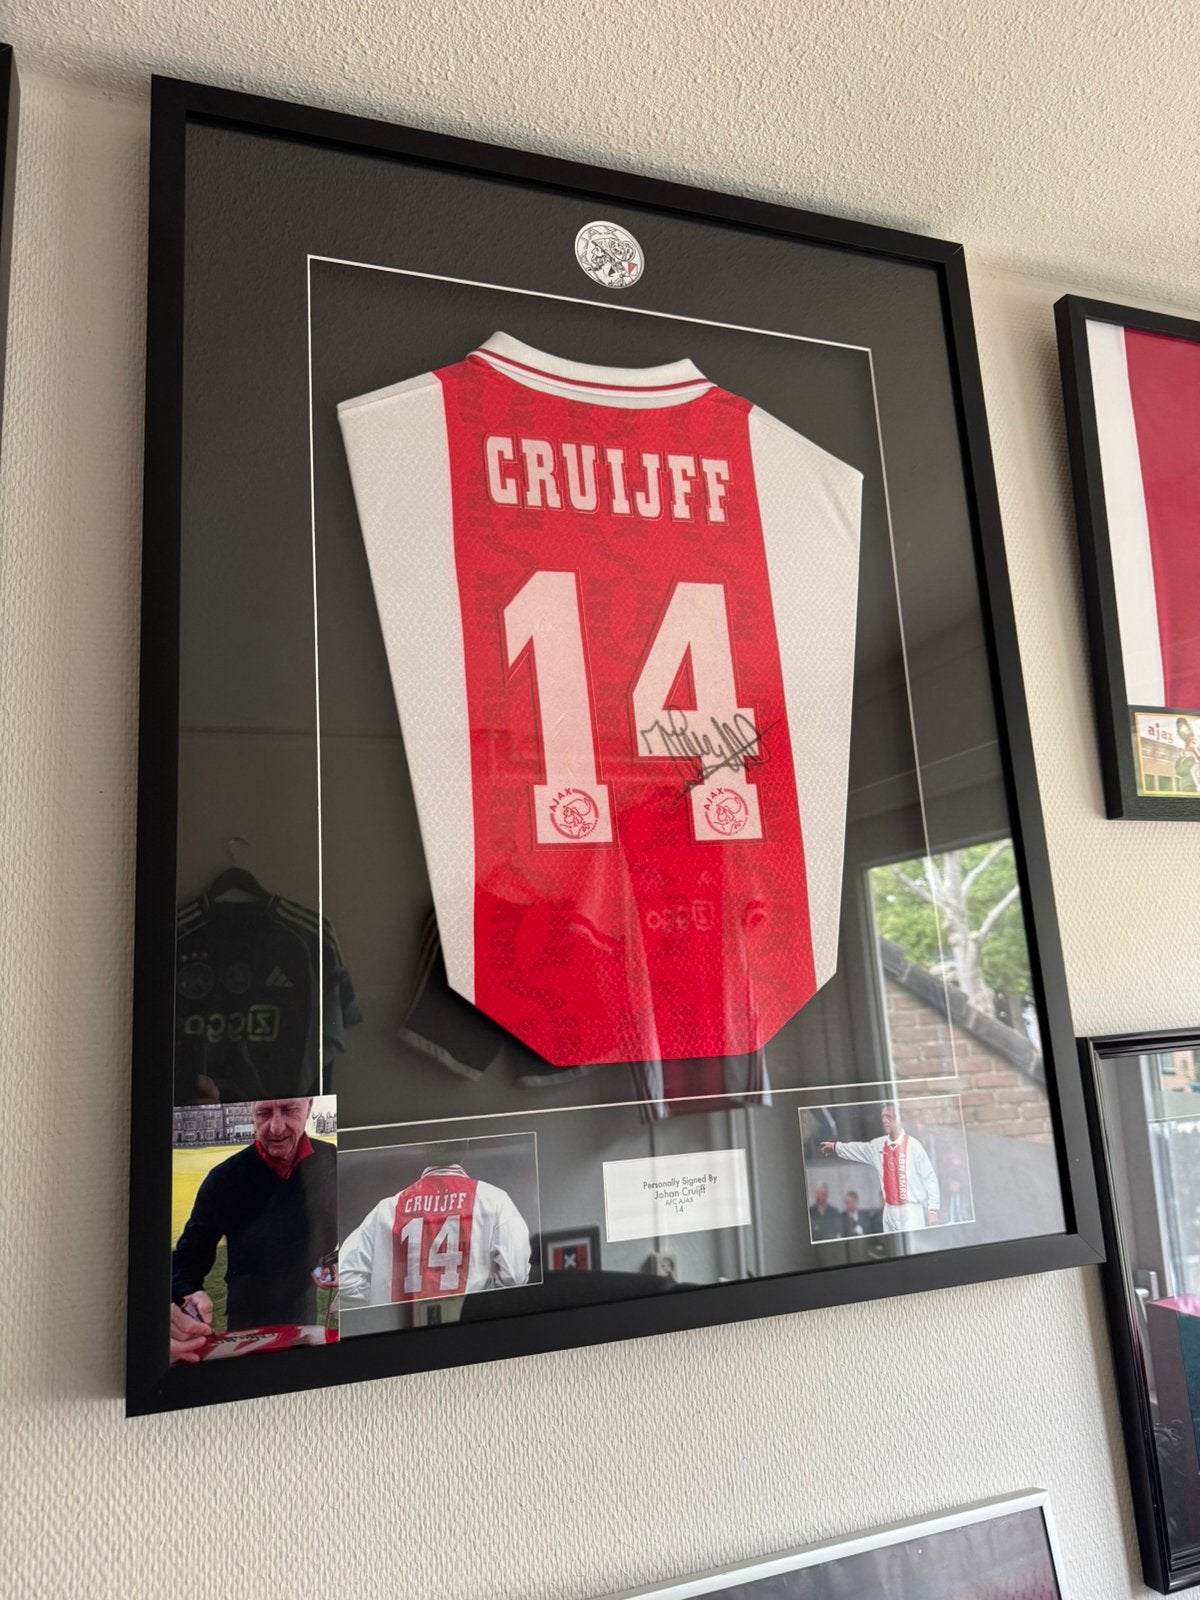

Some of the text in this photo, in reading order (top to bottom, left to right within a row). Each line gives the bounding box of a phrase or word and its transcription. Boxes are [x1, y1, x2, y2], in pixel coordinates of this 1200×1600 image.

[486, 435, 730, 523] CRUIJFF
[503, 570, 763, 845] 14
[549, 788, 572, 812] AJAX
[704, 787, 724, 811] AJAX
[643, 1174, 718, 1190] Personally Signed By
[654, 1184, 706, 1200] Johan Cruijff
[665, 1197, 694, 1206] AFC AJAX
[675, 1205, 684, 1213] 14
[400, 1214, 464, 1294] 14
